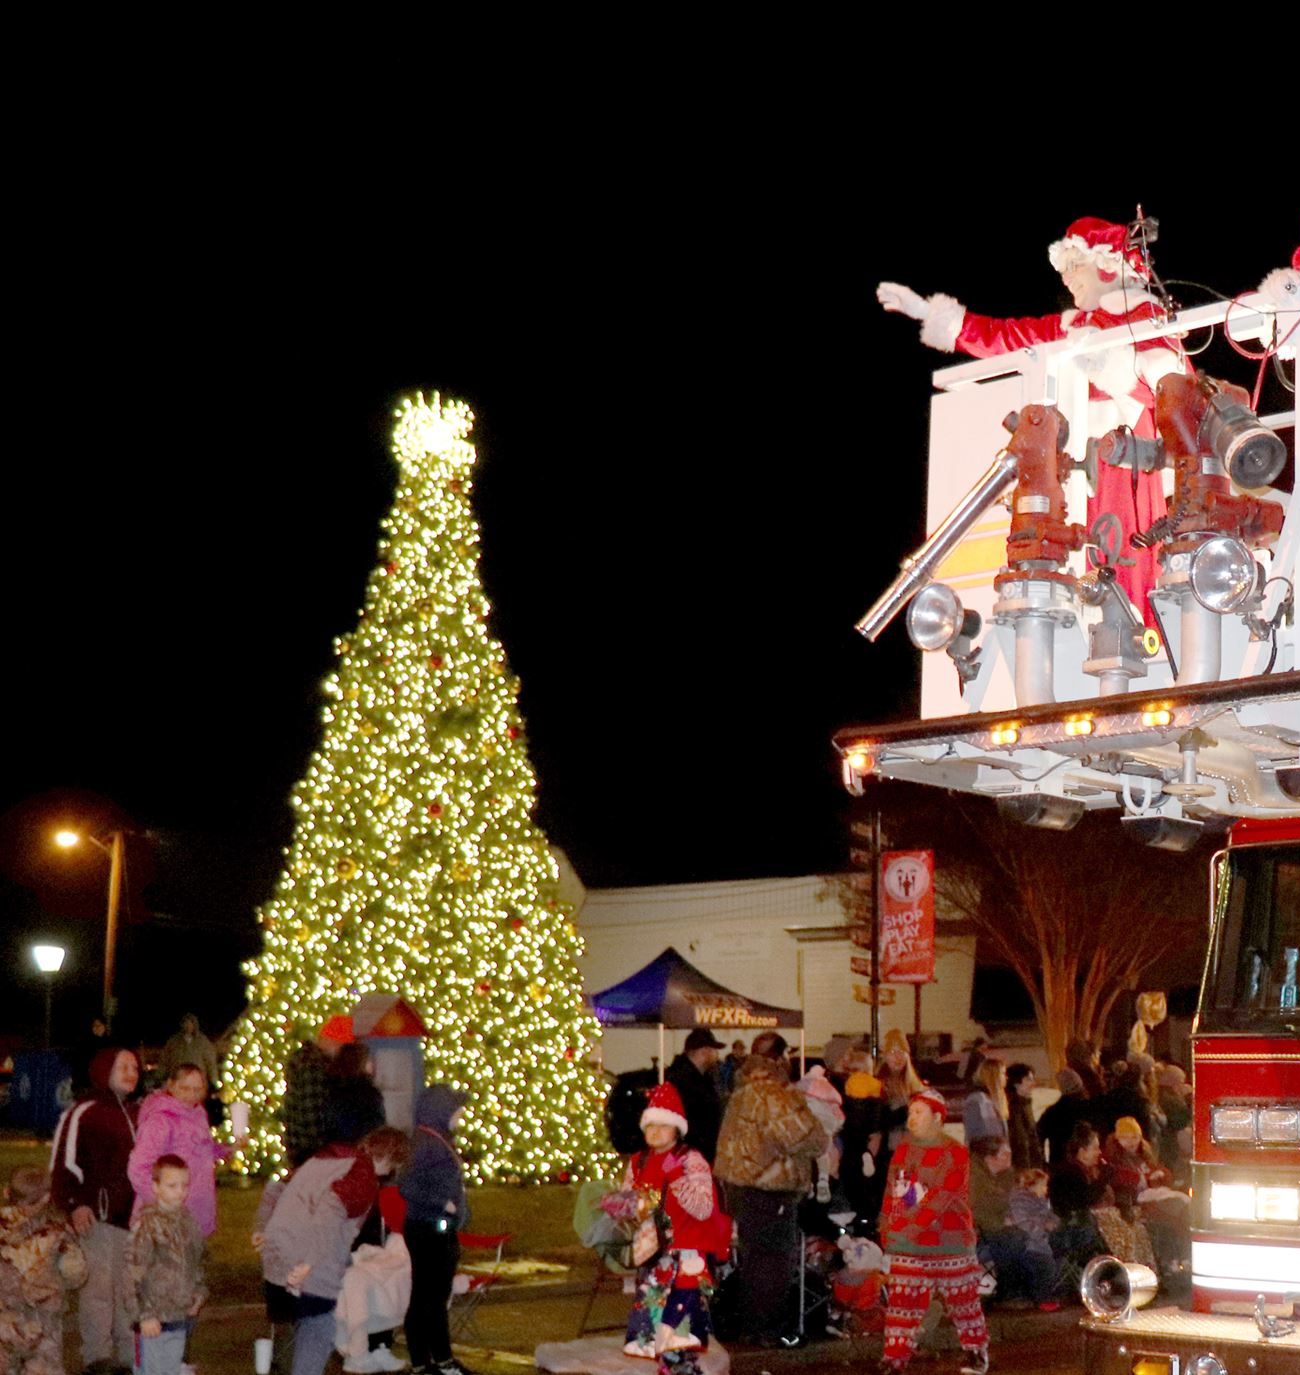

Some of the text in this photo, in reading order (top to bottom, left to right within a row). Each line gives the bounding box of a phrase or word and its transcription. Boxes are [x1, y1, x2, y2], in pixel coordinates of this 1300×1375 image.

[883, 909, 924, 929] SHOP
[886, 924, 920, 941] PLAY
[888, 939, 914, 957] EAT
